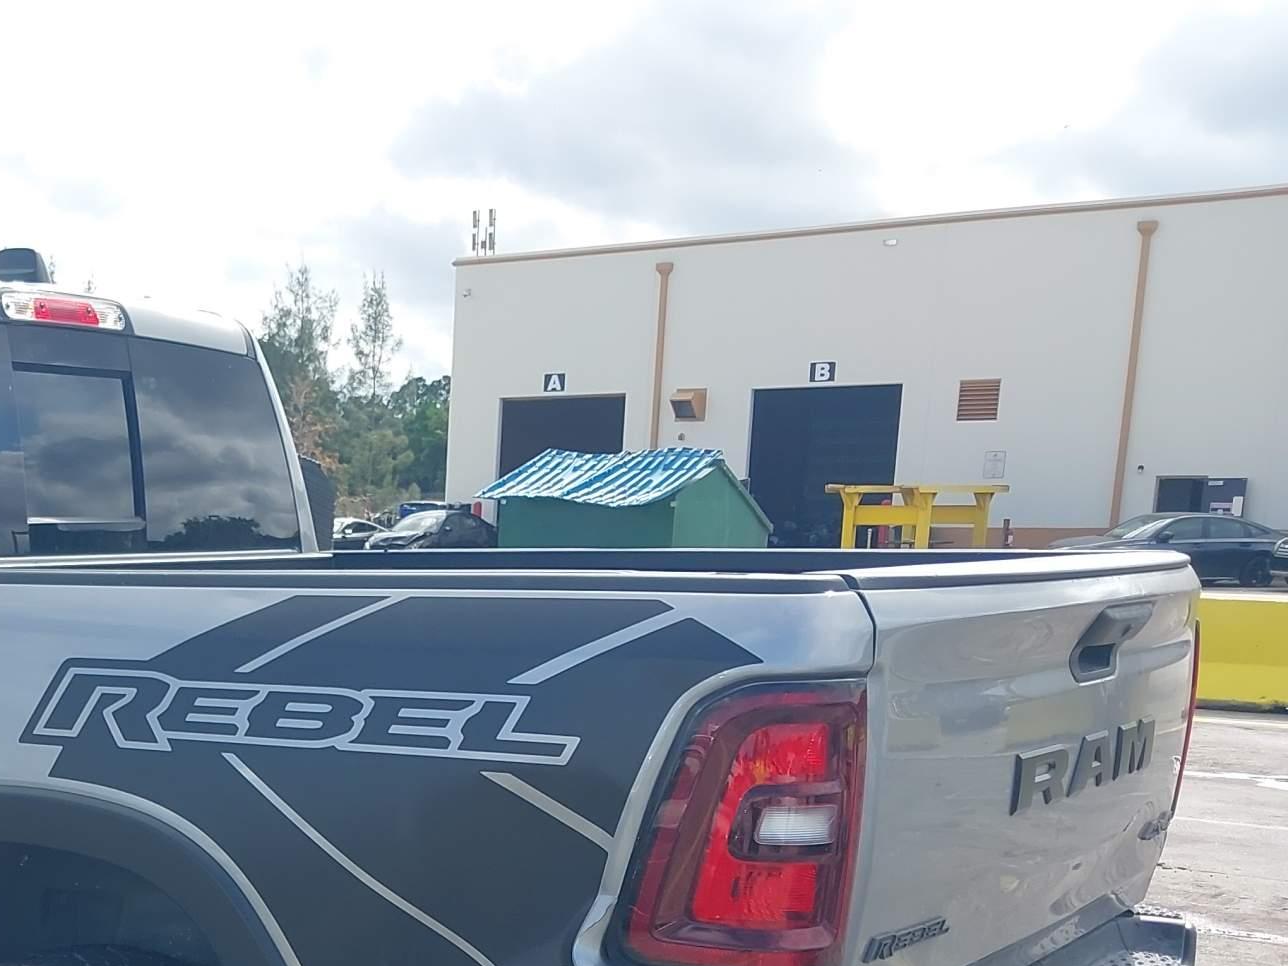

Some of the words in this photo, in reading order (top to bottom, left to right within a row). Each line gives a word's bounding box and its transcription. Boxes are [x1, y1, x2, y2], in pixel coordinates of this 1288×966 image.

[546, 374, 563, 392] A
[814, 362, 832, 382] B
[32, 667, 580, 766] REBEL
[1009, 714, 1155, 817] RAM
[861, 916, 950, 964] REBEL
